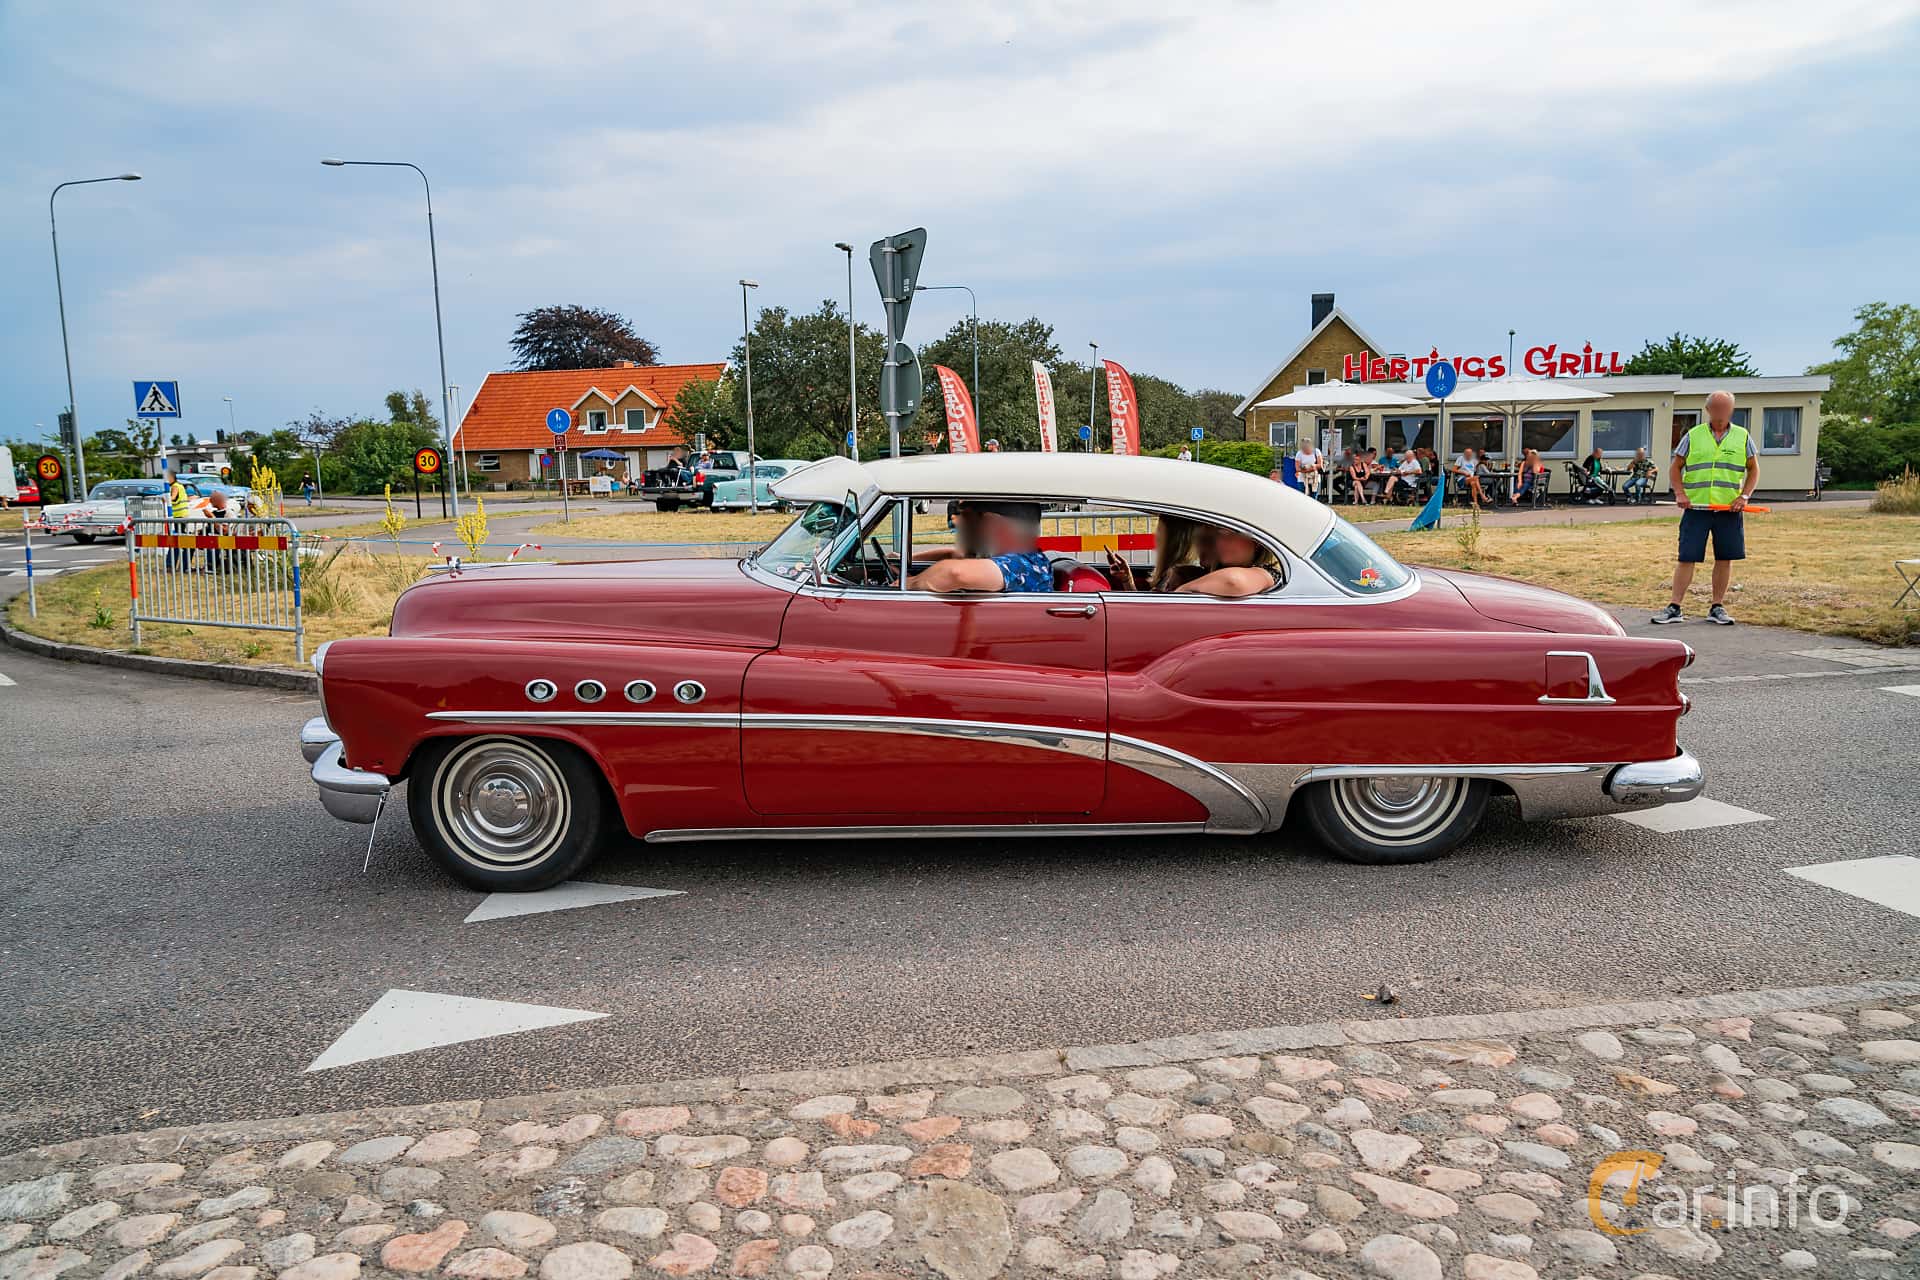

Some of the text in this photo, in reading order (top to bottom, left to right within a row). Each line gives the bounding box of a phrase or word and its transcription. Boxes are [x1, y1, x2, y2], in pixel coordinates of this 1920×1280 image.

[1524, 341, 1626, 378] GRILL
[420, 455, 436, 467] 30
[42, 462, 57, 474] 30
